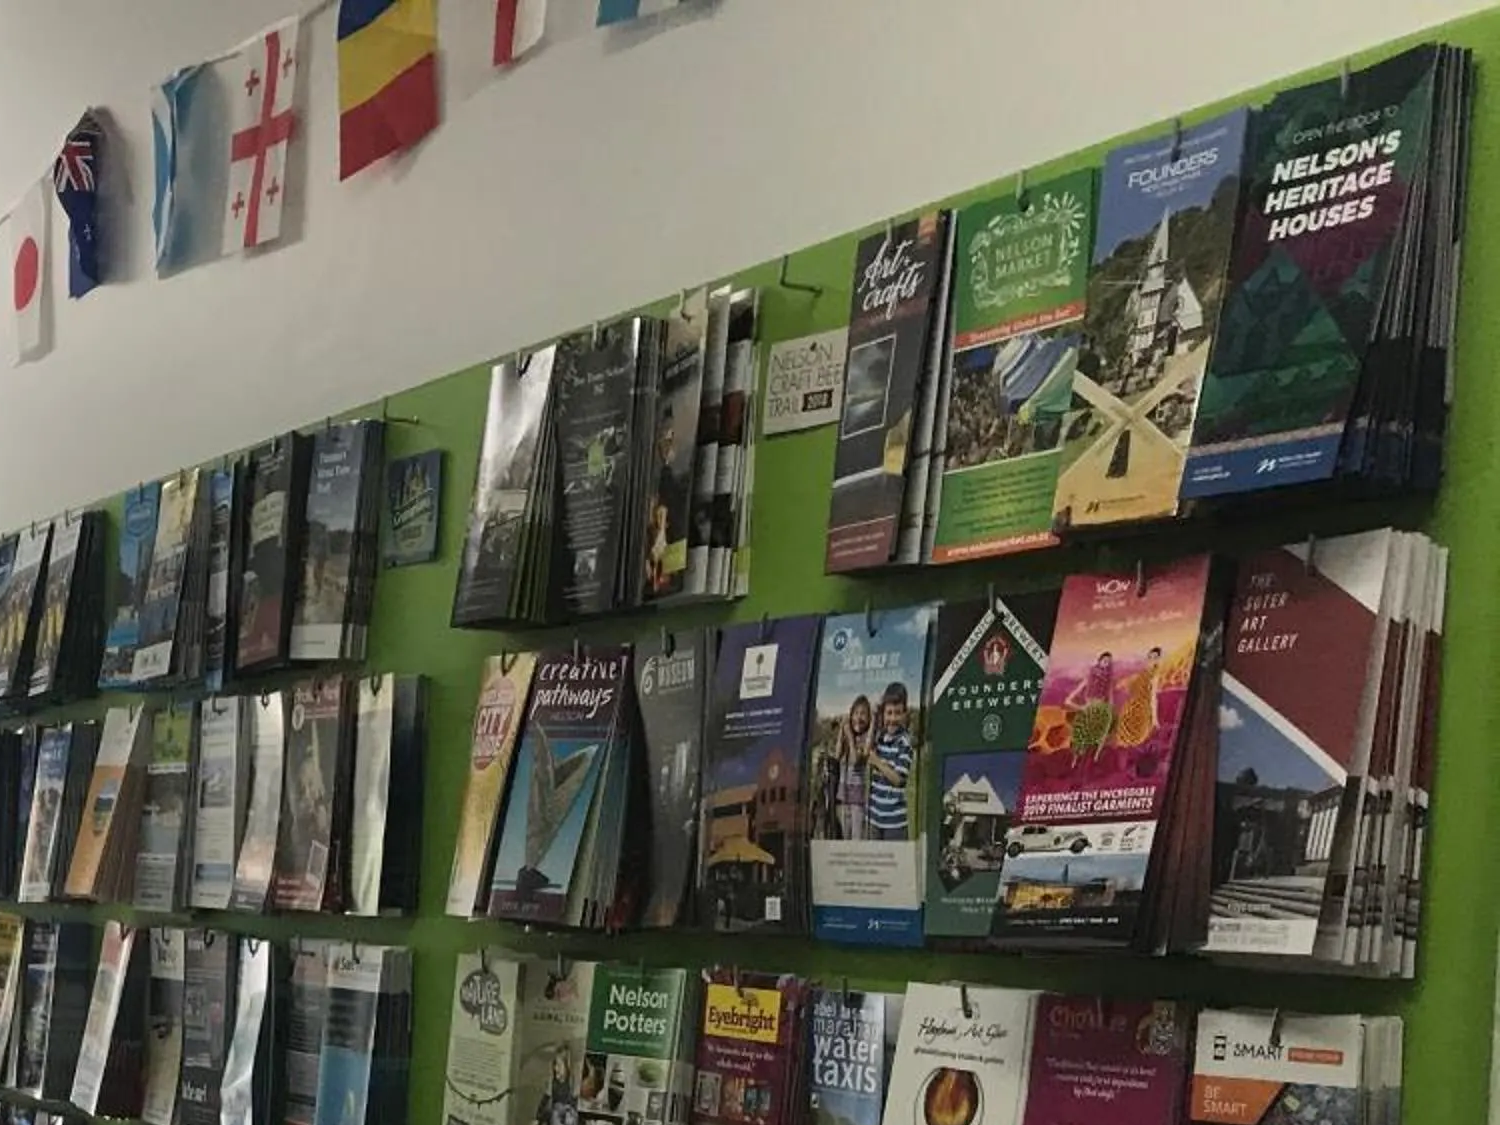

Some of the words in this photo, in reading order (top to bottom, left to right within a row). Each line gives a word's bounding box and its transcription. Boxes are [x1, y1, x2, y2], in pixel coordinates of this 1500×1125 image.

[1128, 148, 1219, 188] FOUNDERS
[1272, 130, 1401, 185] NELSON'S
[1264, 160, 1396, 214] HERITAGE
[1268, 195, 1376, 241] HOUSES
[995, 233, 1052, 261] NELSON
[995, 252, 1051, 278] MARKET
[772, 343, 833, 372] NELSON
[770, 369, 811, 396] CRAFT
[817, 363, 842, 386] BEE
[1240, 615, 1268, 633] ART
[1237, 633, 1299, 654] GALLERY
[530, 683, 614, 721] pathways
[947, 680, 1044, 697] FOUNDERS
[1023, 803, 1046, 817] 2019
[1047, 800, 1092, 814] FINALIST
[1093, 796, 1154, 811] GARMENTS
[1026, 791, 1080, 804] EXPERIENCE
[1081, 790, 1097, 800] THE
[1099, 786, 1156, 799] INCREDIBLE
[609, 984, 669, 1008] Nelson
[603, 1010, 666, 1036] Potters
[708, 1005, 776, 1034] Eyebright
[813, 1035, 878, 1065] water
[1233, 1043, 1284, 1060] SMART
[813, 1056, 878, 1093] taxis
[1204, 1085, 1220, 1099] BE
[1203, 1101, 1247, 1118] SMART
